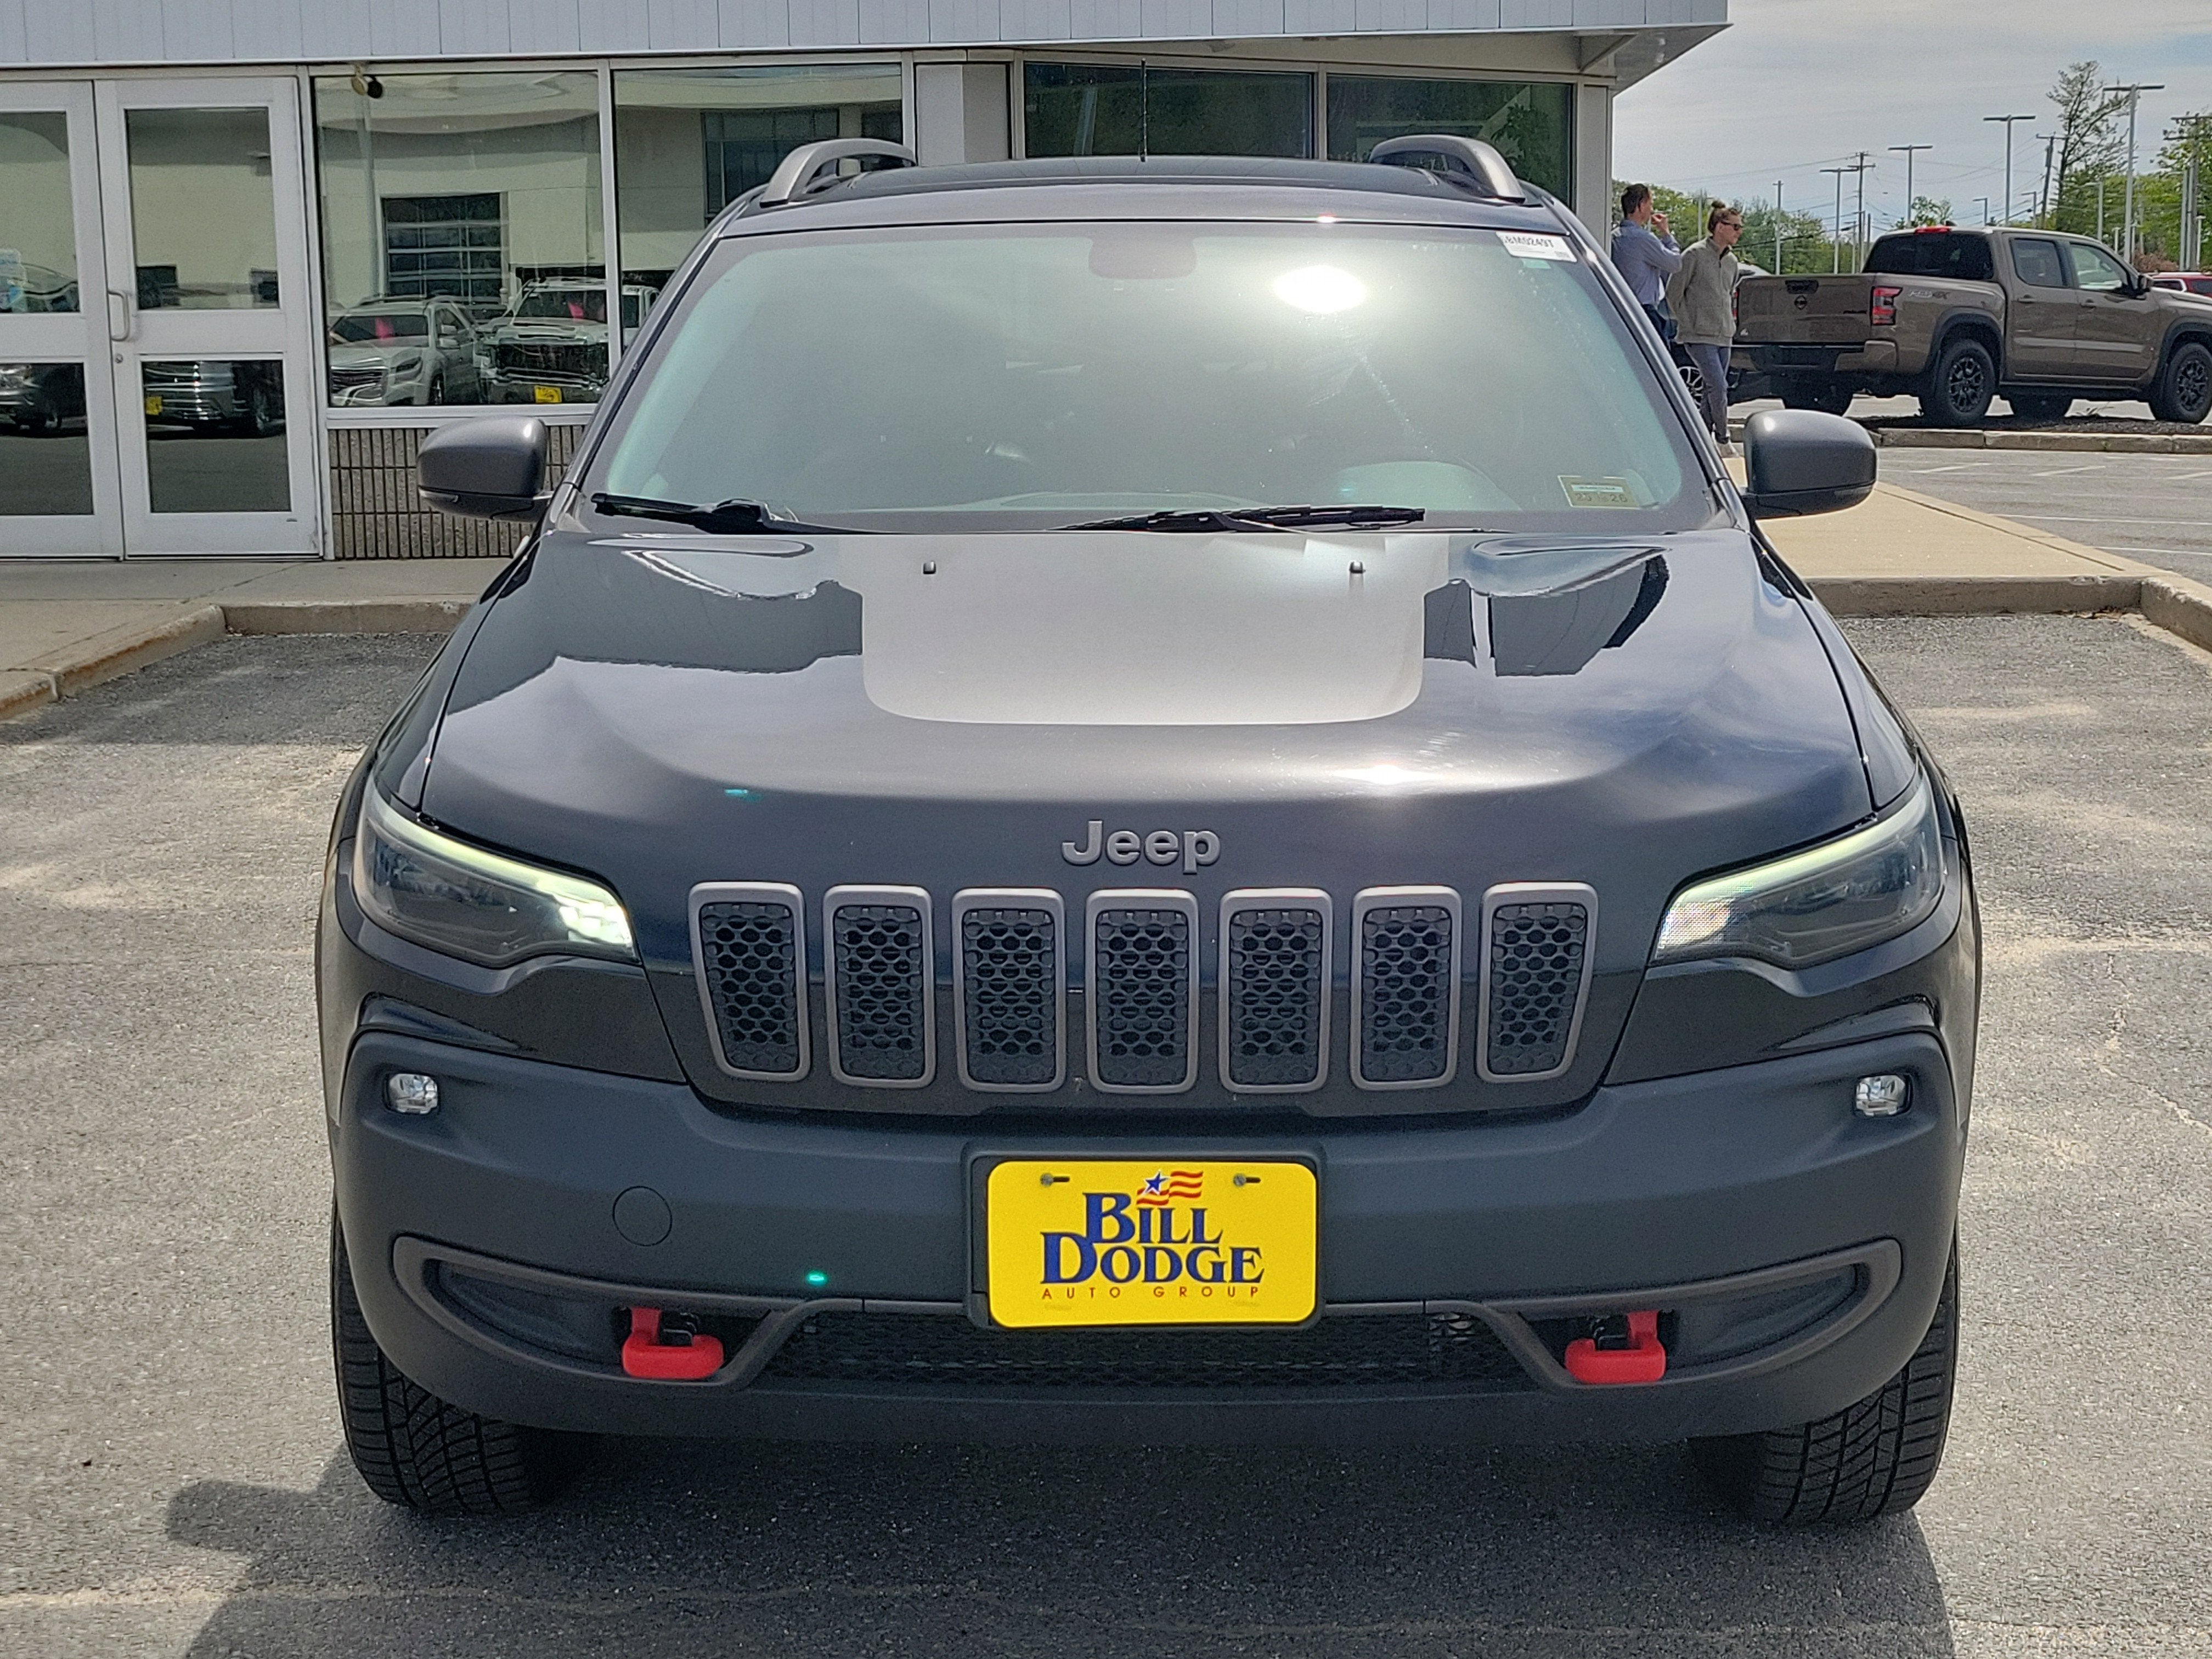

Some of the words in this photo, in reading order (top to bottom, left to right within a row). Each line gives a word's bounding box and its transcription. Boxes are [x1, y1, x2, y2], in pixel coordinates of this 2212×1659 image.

[1062, 820, 1221, 875] Jeep
[1082, 1192, 1223, 1244] BILL
[1040, 1232, 1265, 1284] DODGE
[1042, 1286, 1121, 1300] AUTO
[1153, 1286, 1259, 1299] GROUP
